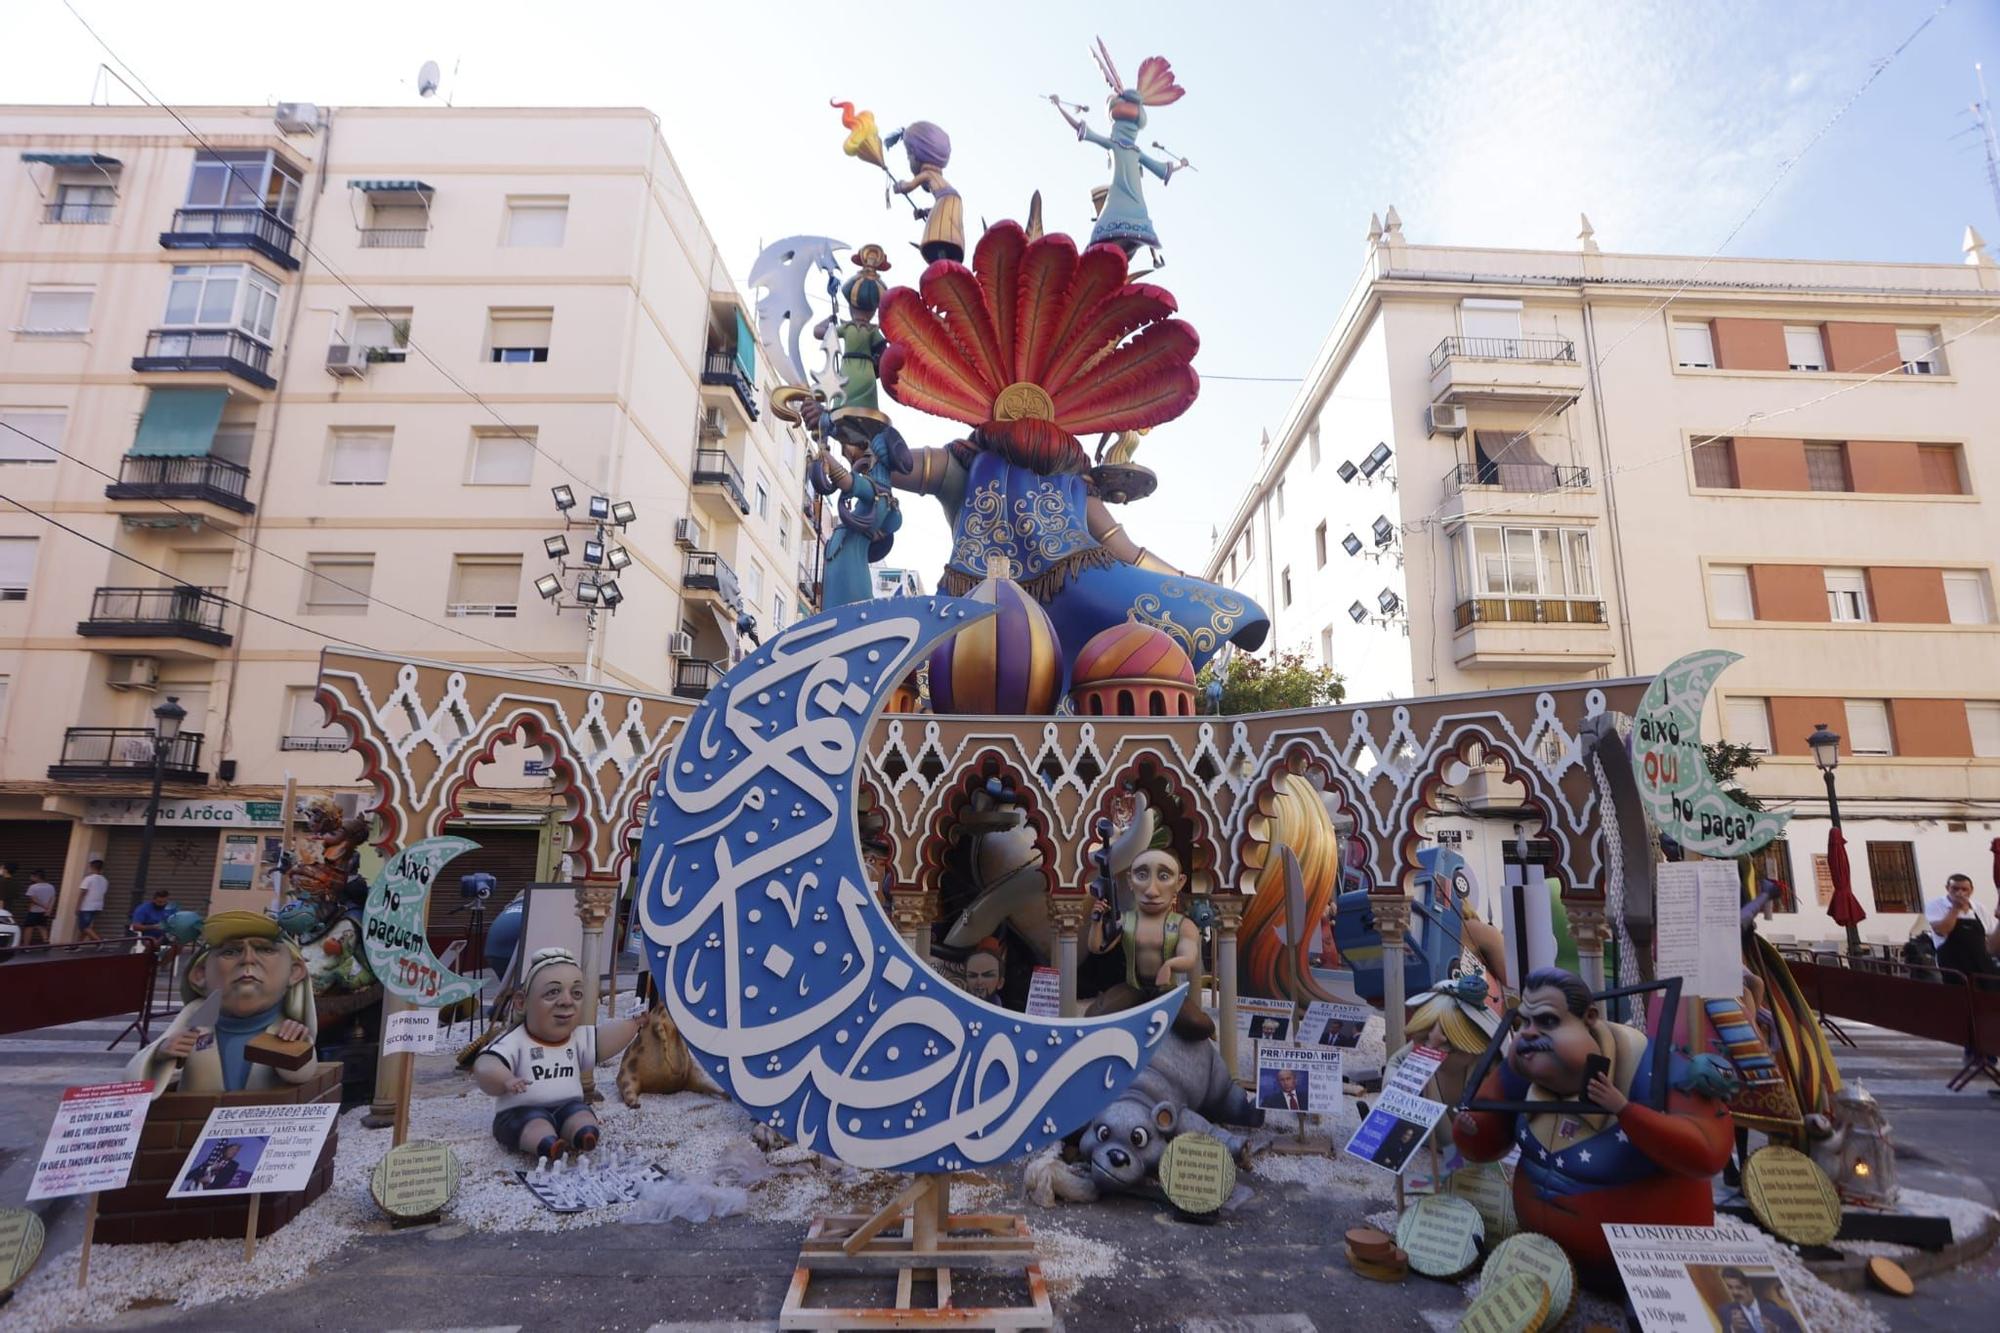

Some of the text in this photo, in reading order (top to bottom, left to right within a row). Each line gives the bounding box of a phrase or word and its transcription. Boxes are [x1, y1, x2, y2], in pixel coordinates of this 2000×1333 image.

[1663, 678, 1669, 705] I
[1644, 751, 1678, 788] QUI
[1671, 790, 1756, 845] ho paga?
[383, 884, 400, 912] ho
[366, 916, 423, 955] paguem
[399, 957, 443, 997] TOTS!
[77, 1113, 93, 1123] COVID
[1611, 1226, 1753, 1242] EL UNIPERSONAL
[1649, 1286, 1671, 1300] hablo
